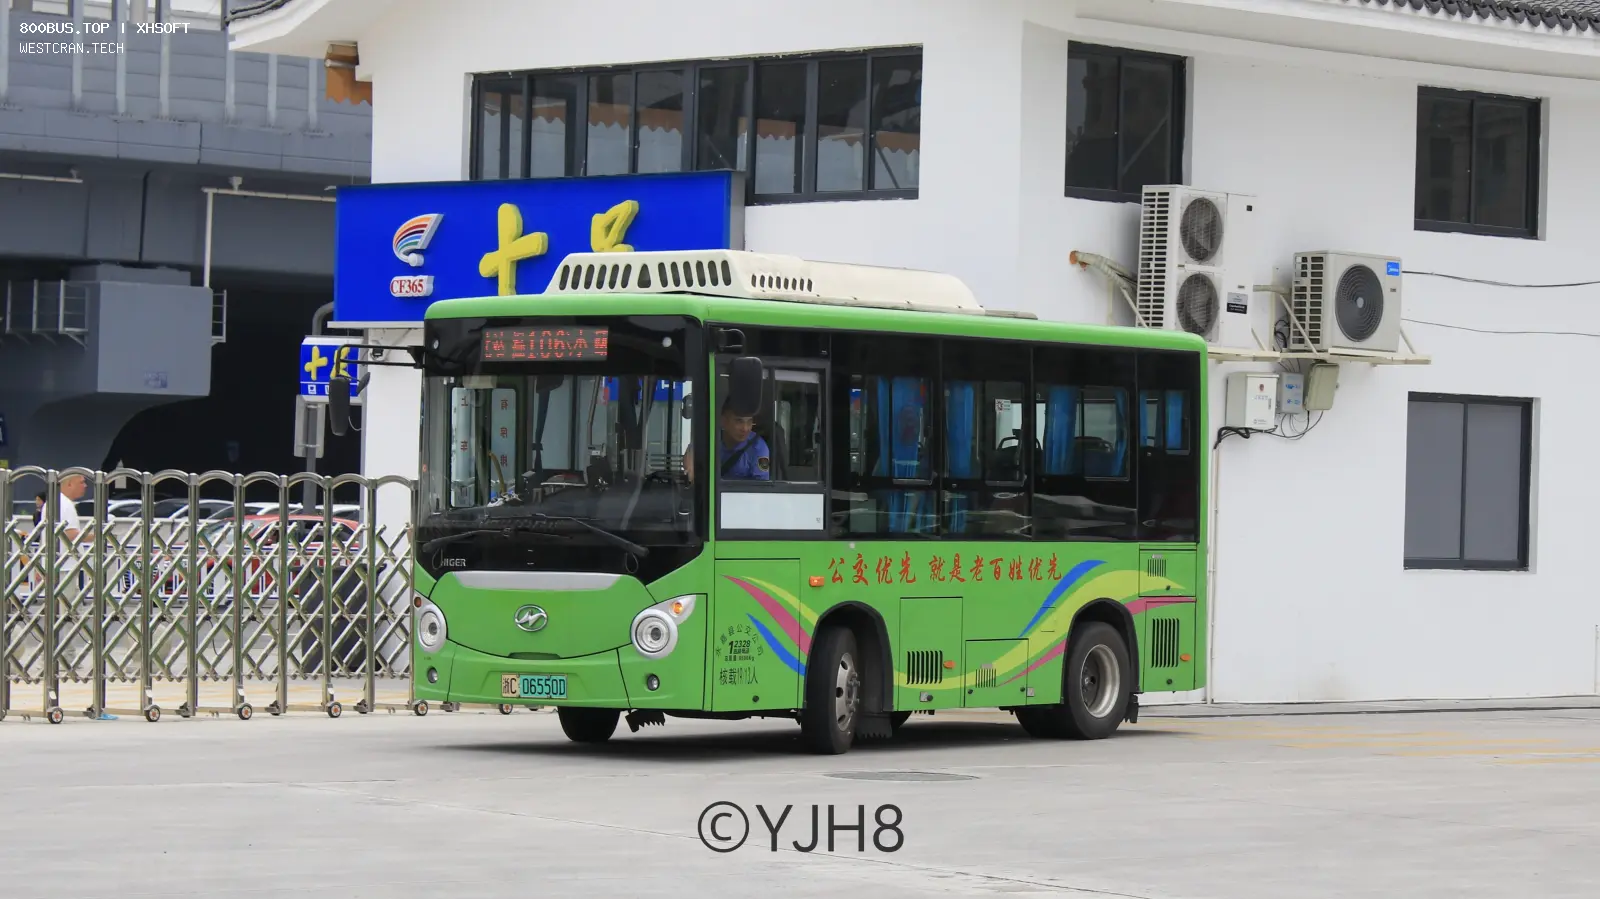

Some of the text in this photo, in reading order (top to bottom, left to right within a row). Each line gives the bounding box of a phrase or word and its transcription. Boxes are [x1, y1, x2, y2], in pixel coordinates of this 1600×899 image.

[390, 279, 424, 294] CF365
[828, 551, 1062, 586] 公交优先 就是老百姓优先
[728, 640, 751, 654] 12328
